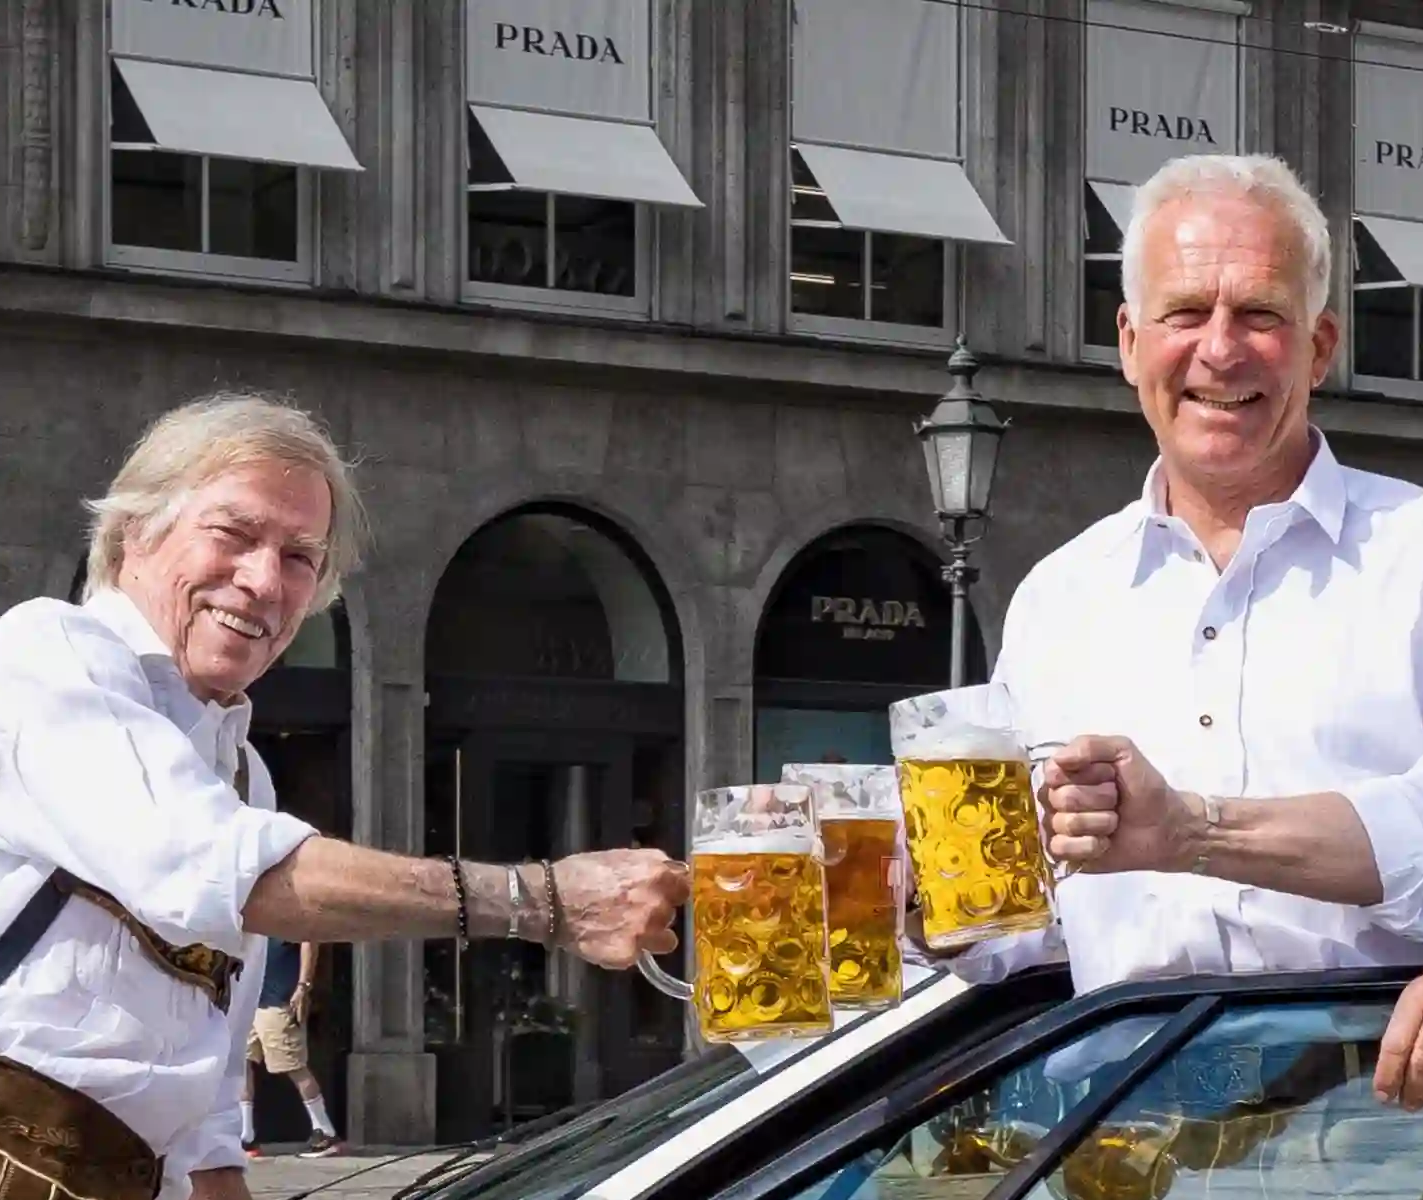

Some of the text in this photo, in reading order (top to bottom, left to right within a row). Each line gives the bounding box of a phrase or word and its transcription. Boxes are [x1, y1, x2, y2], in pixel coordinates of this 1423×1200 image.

[493, 21, 625, 65] PRADA
[1109, 106, 1218, 145] PRADA
[810, 595, 926, 629] PRADA
